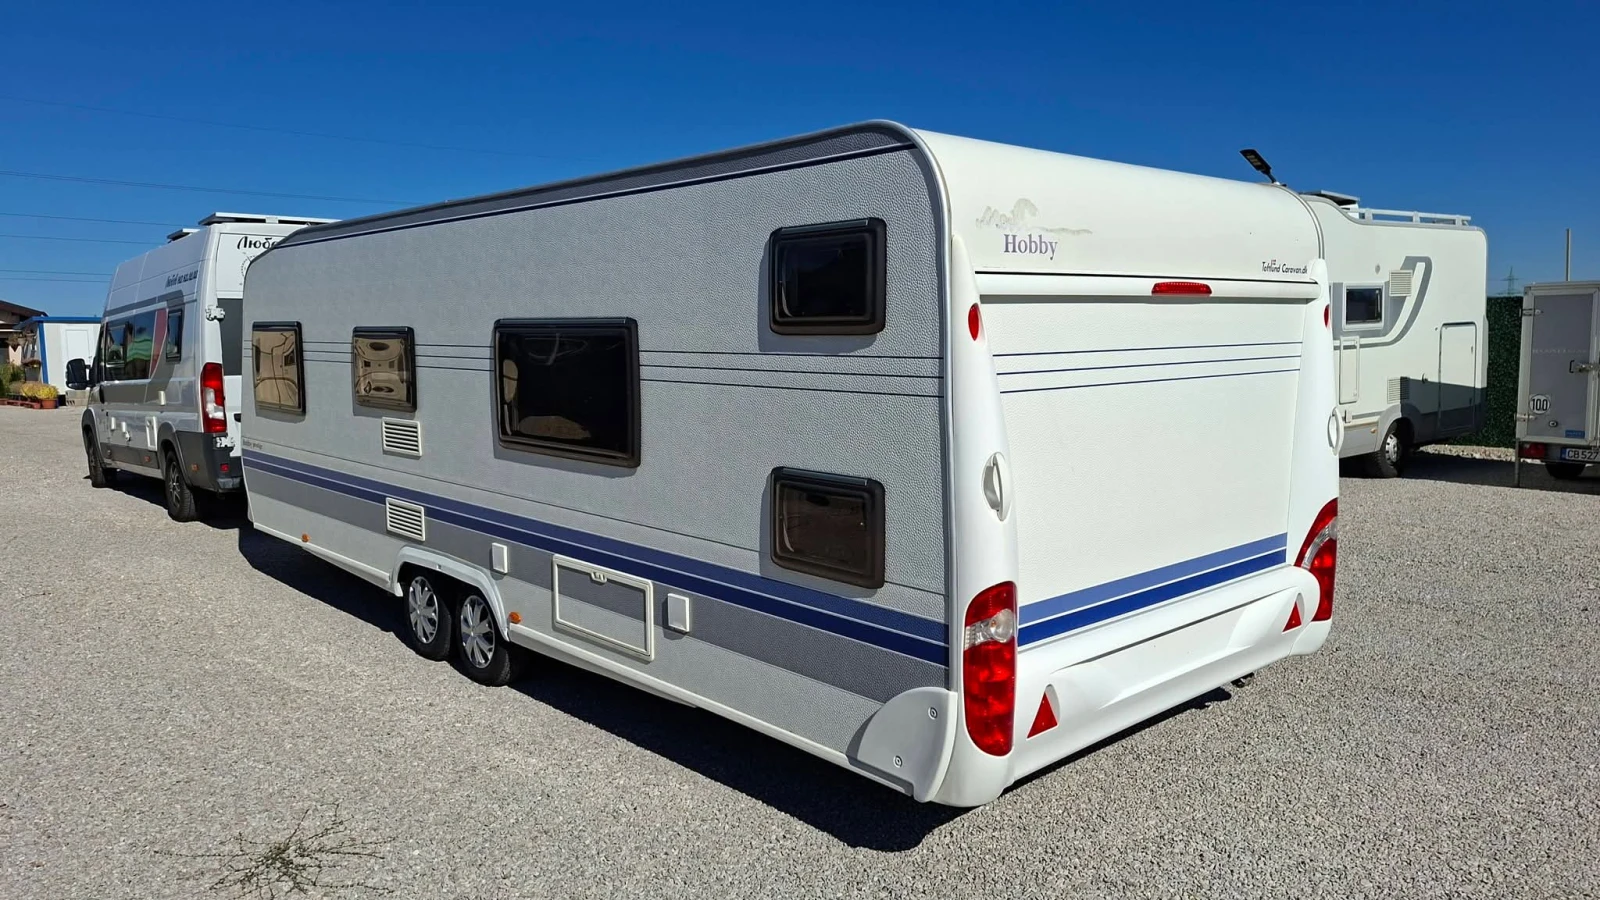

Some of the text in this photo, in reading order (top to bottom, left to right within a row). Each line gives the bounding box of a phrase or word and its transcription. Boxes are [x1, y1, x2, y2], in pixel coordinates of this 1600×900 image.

[1003, 233, 1058, 261] Hobby
[1531, 398, 1548, 412] 100
[1581, 450, 1599, 460] 527
